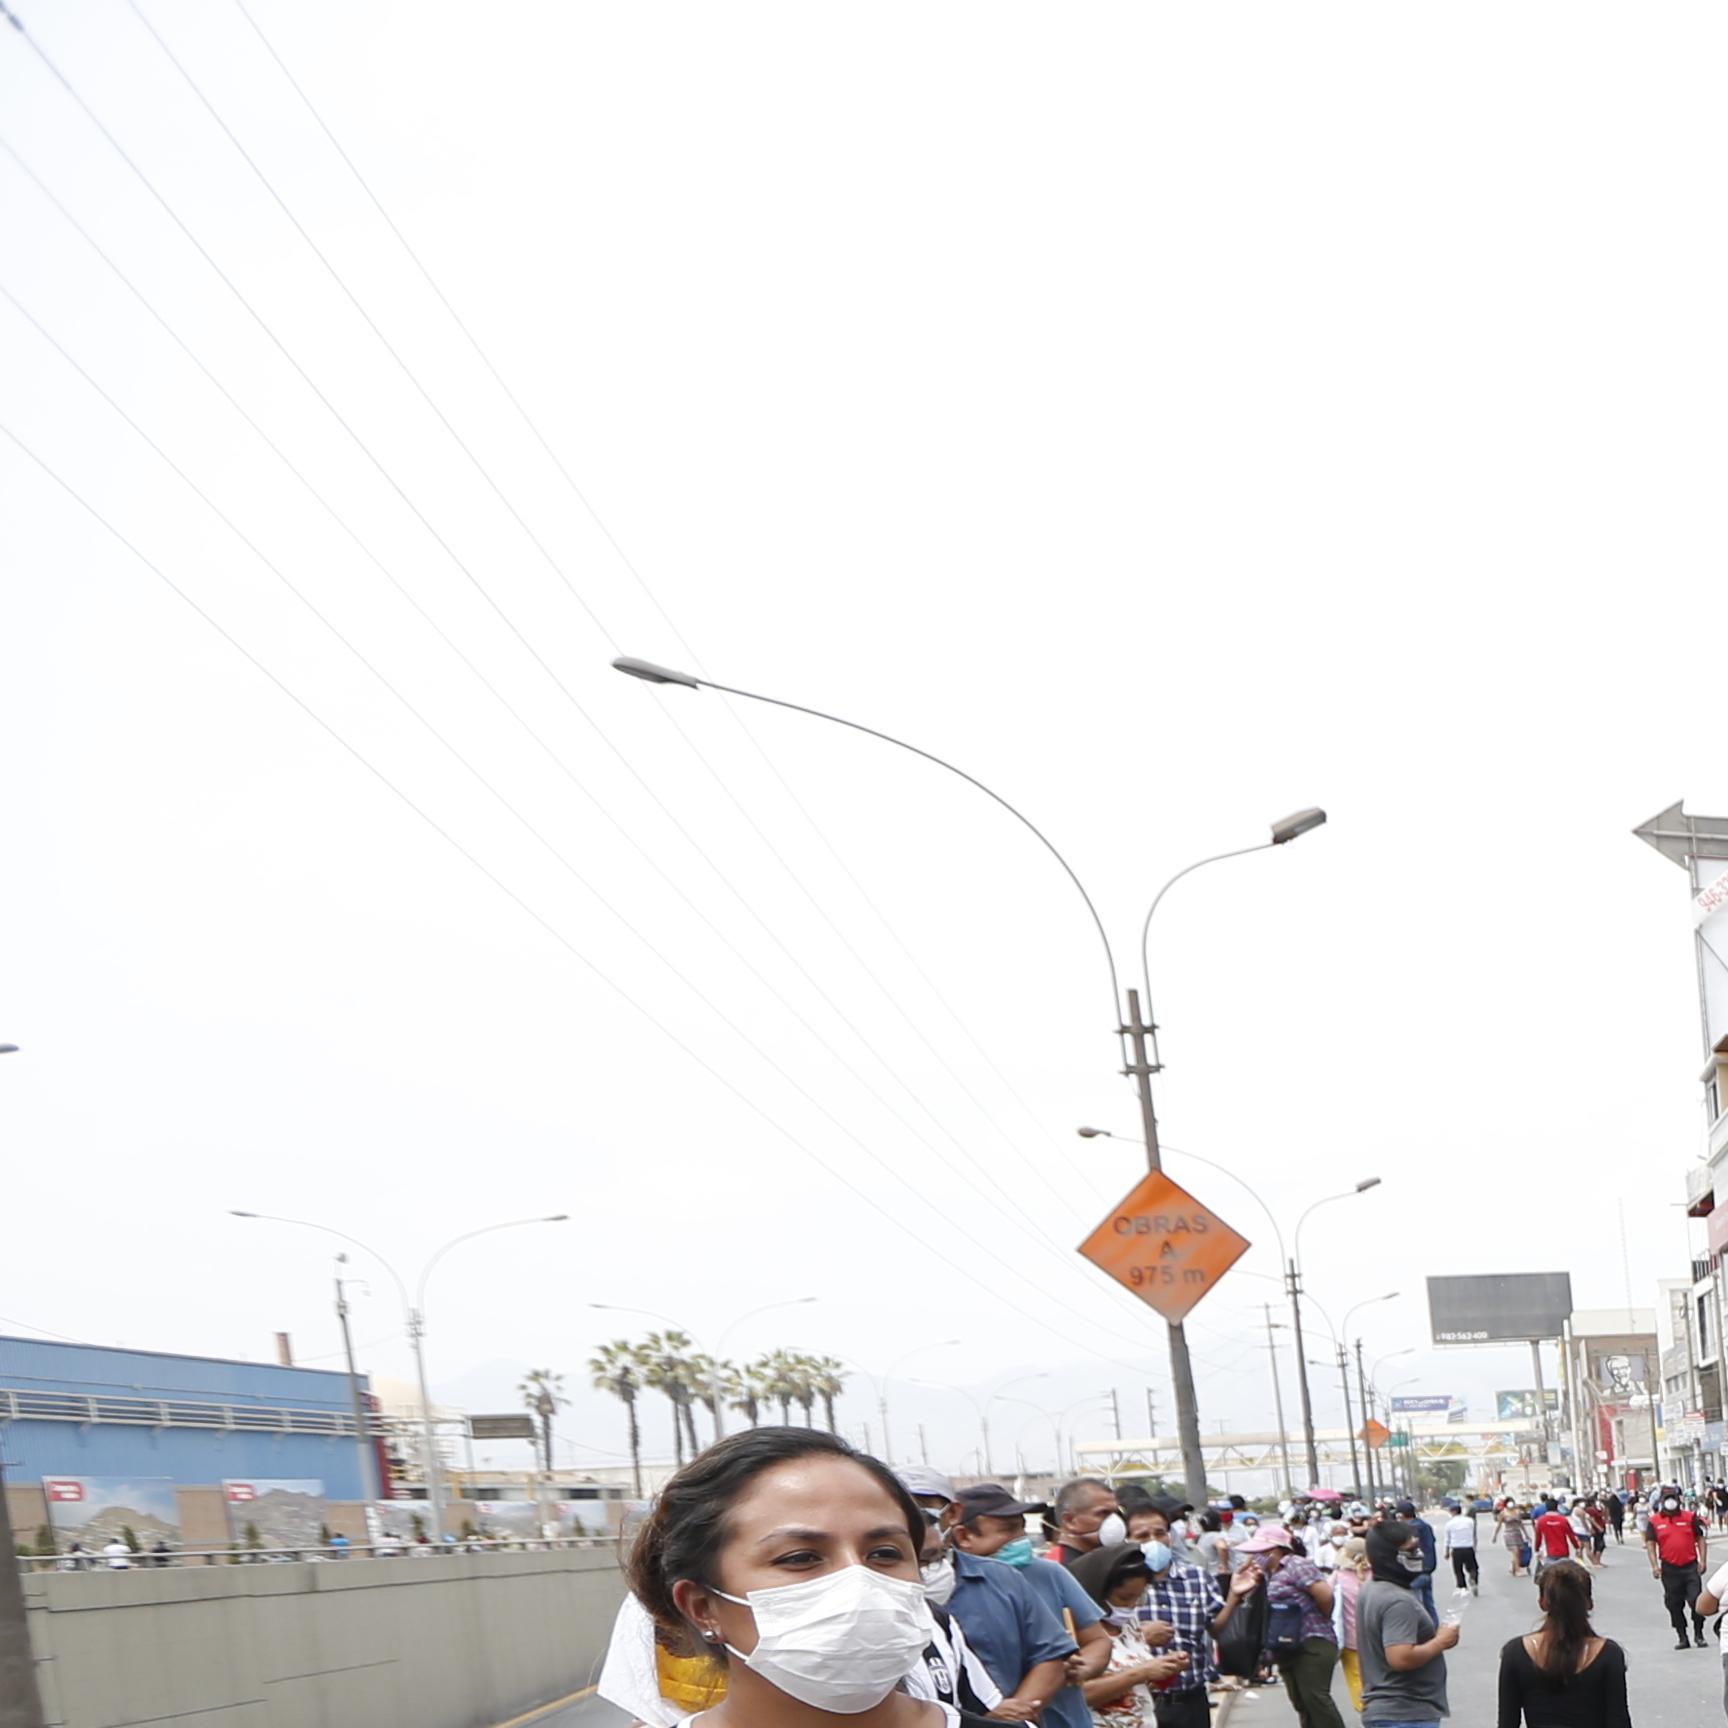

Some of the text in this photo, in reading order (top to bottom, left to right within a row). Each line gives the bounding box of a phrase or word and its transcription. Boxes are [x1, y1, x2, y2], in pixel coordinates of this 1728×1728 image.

[1113, 1215, 1208, 1235] OBRAS
[1160, 1240, 1175, 1258] A
[1129, 1266, 1205, 1285] 975 m
